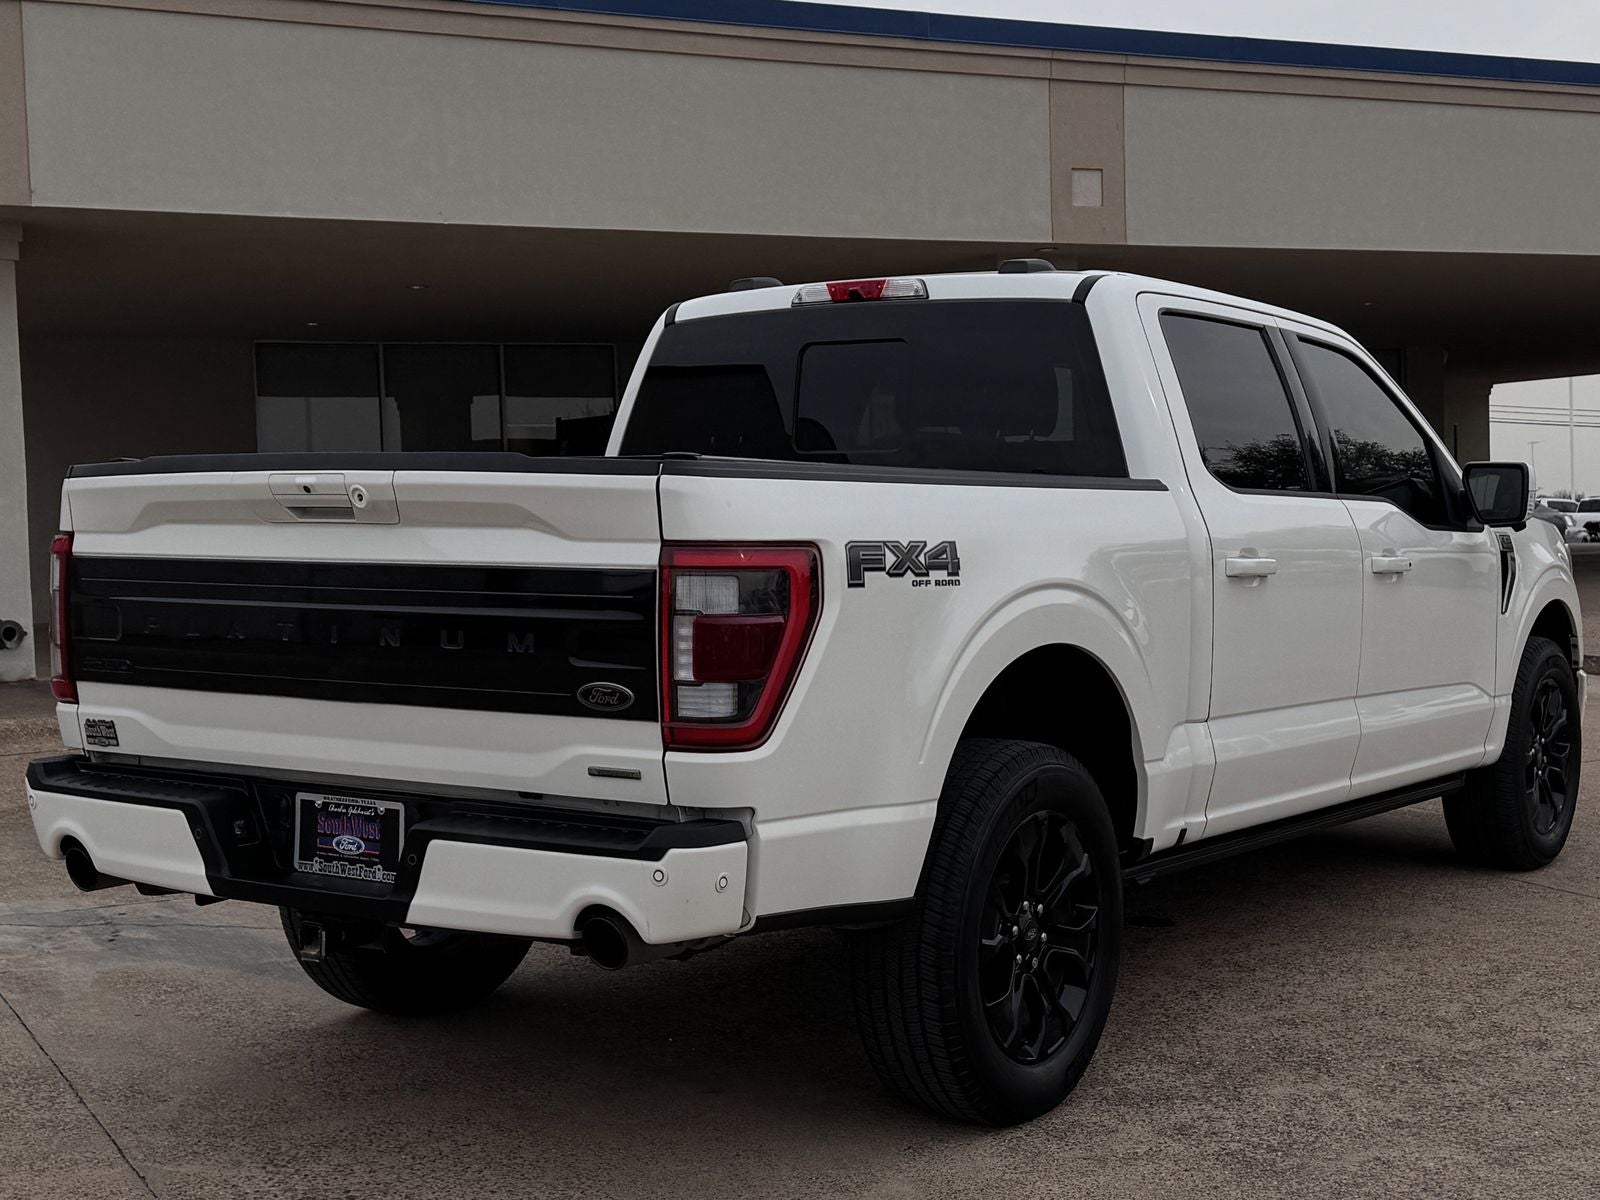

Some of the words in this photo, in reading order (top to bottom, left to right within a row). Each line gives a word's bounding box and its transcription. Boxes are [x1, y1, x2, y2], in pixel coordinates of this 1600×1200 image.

[845, 540, 961, 589] FX4
[911, 579, 931, 587] OFF
[934, 578, 961, 587] ROAD
[143, 616, 536, 654] PLATINUM
